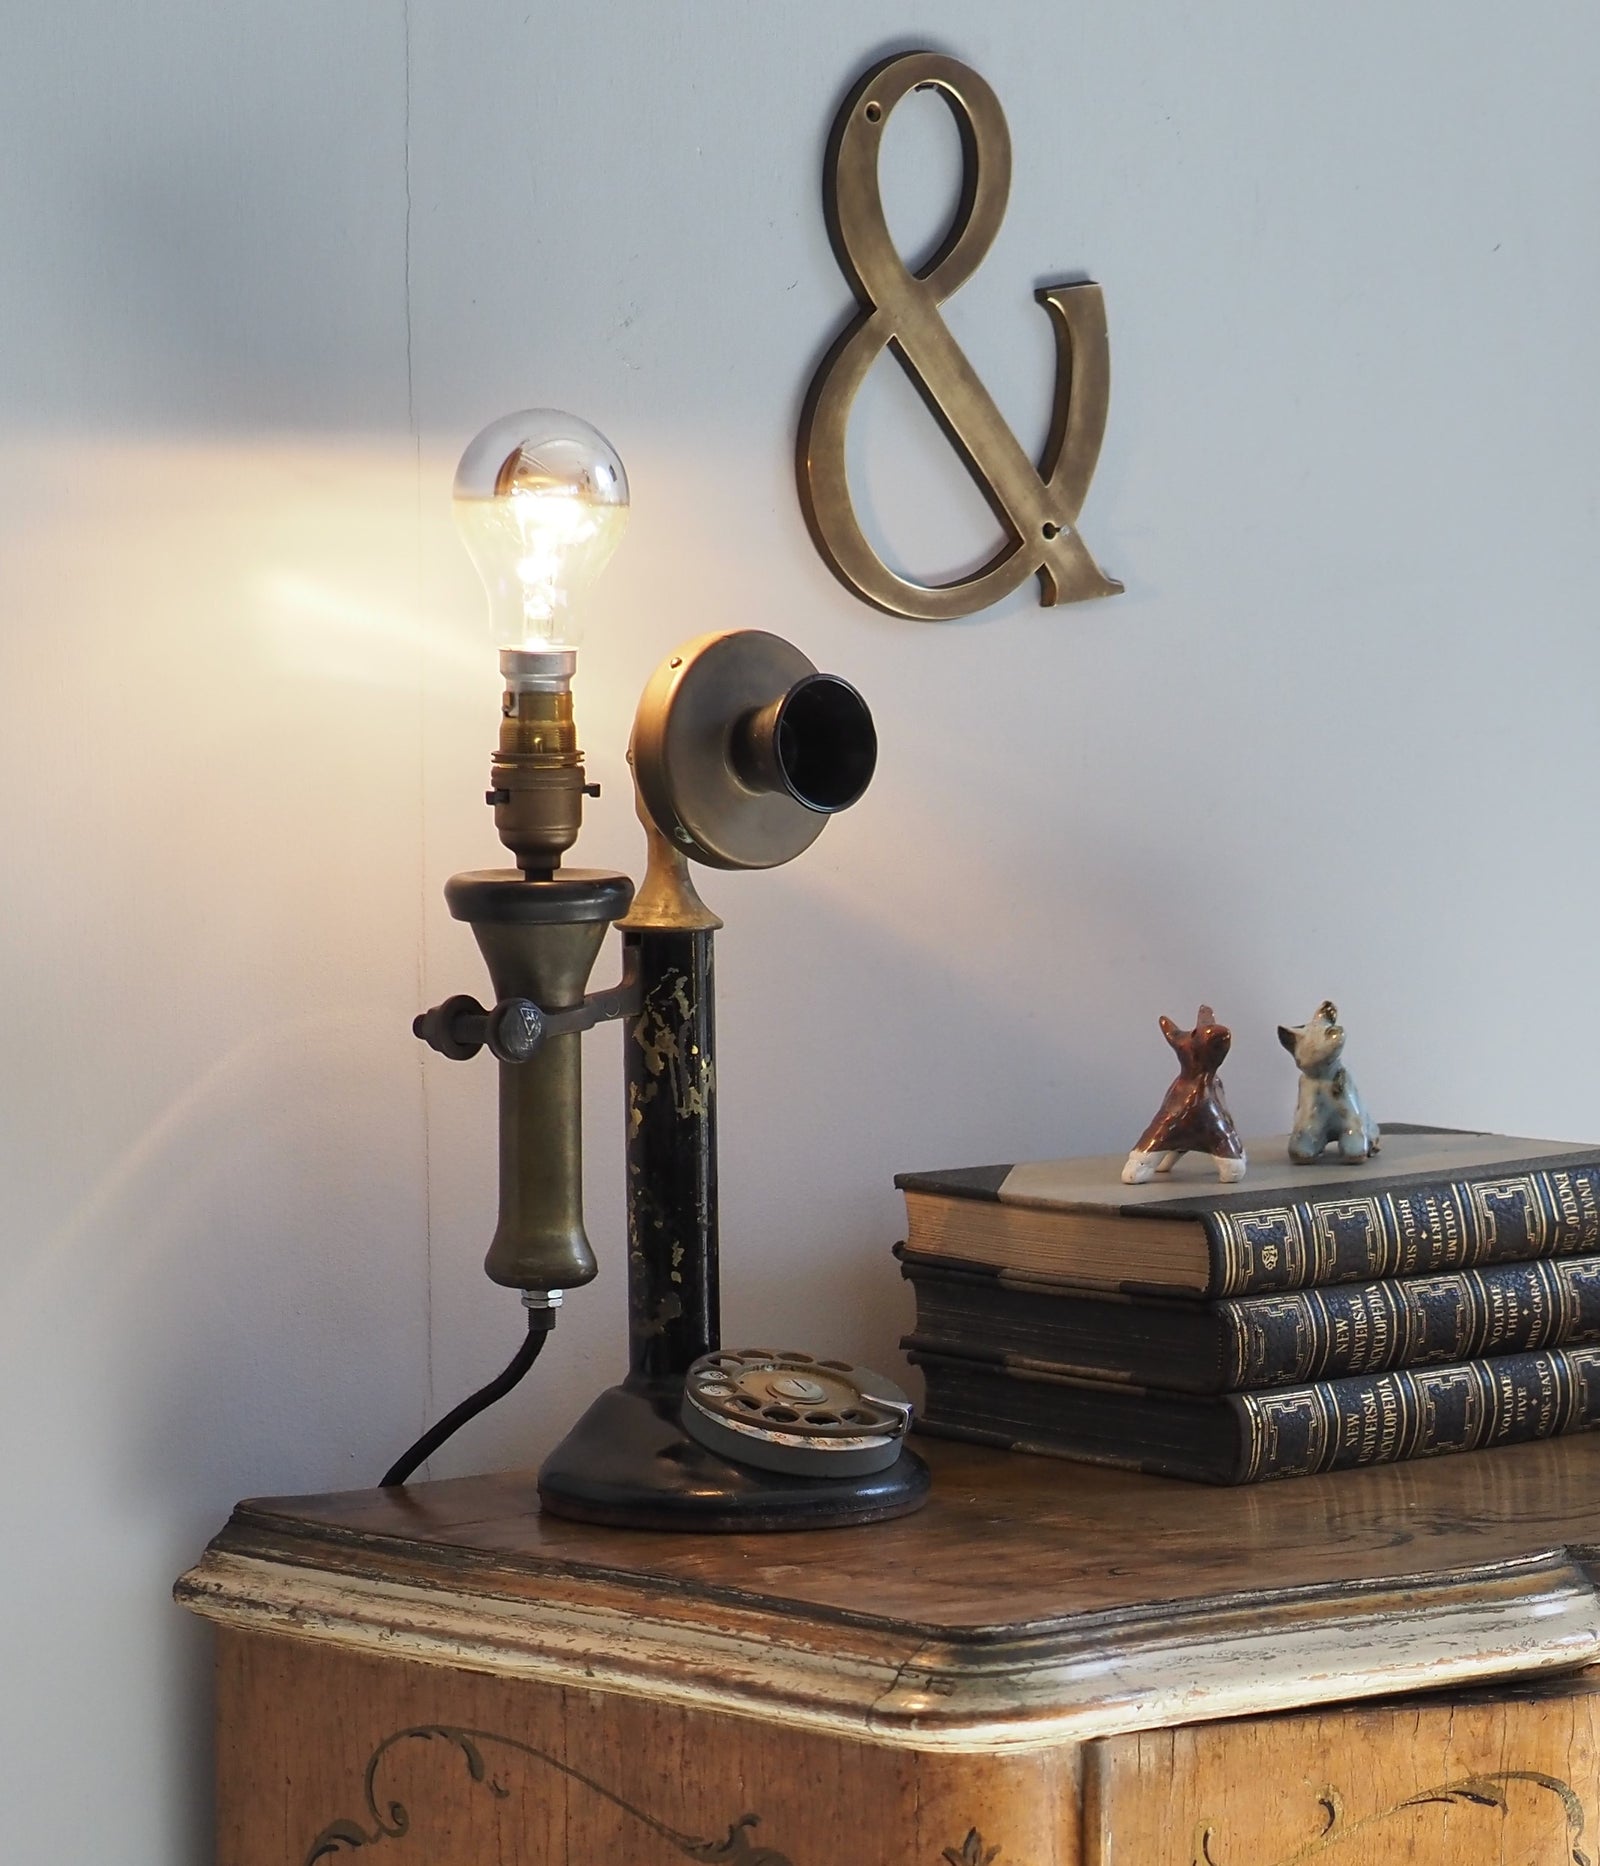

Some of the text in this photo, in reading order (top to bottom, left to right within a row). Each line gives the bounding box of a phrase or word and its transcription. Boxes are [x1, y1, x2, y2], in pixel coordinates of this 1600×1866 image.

[797, 50, 1124, 622] &
[1335, 1318, 1350, 1354] NEW
[1347, 1294, 1368, 1369] UNIVERSAL
[1363, 1285, 1388, 1373] NCYCLOPEDIA
[1489, 1284, 1505, 1346] VOLUME
[1505, 1286, 1519, 1338] THREE
[1345, 1413, 1361, 1447] NEW
[1358, 1388, 1378, 1462] UNIVERSAL
[1498, 1375, 1514, 1437] VOLUME
